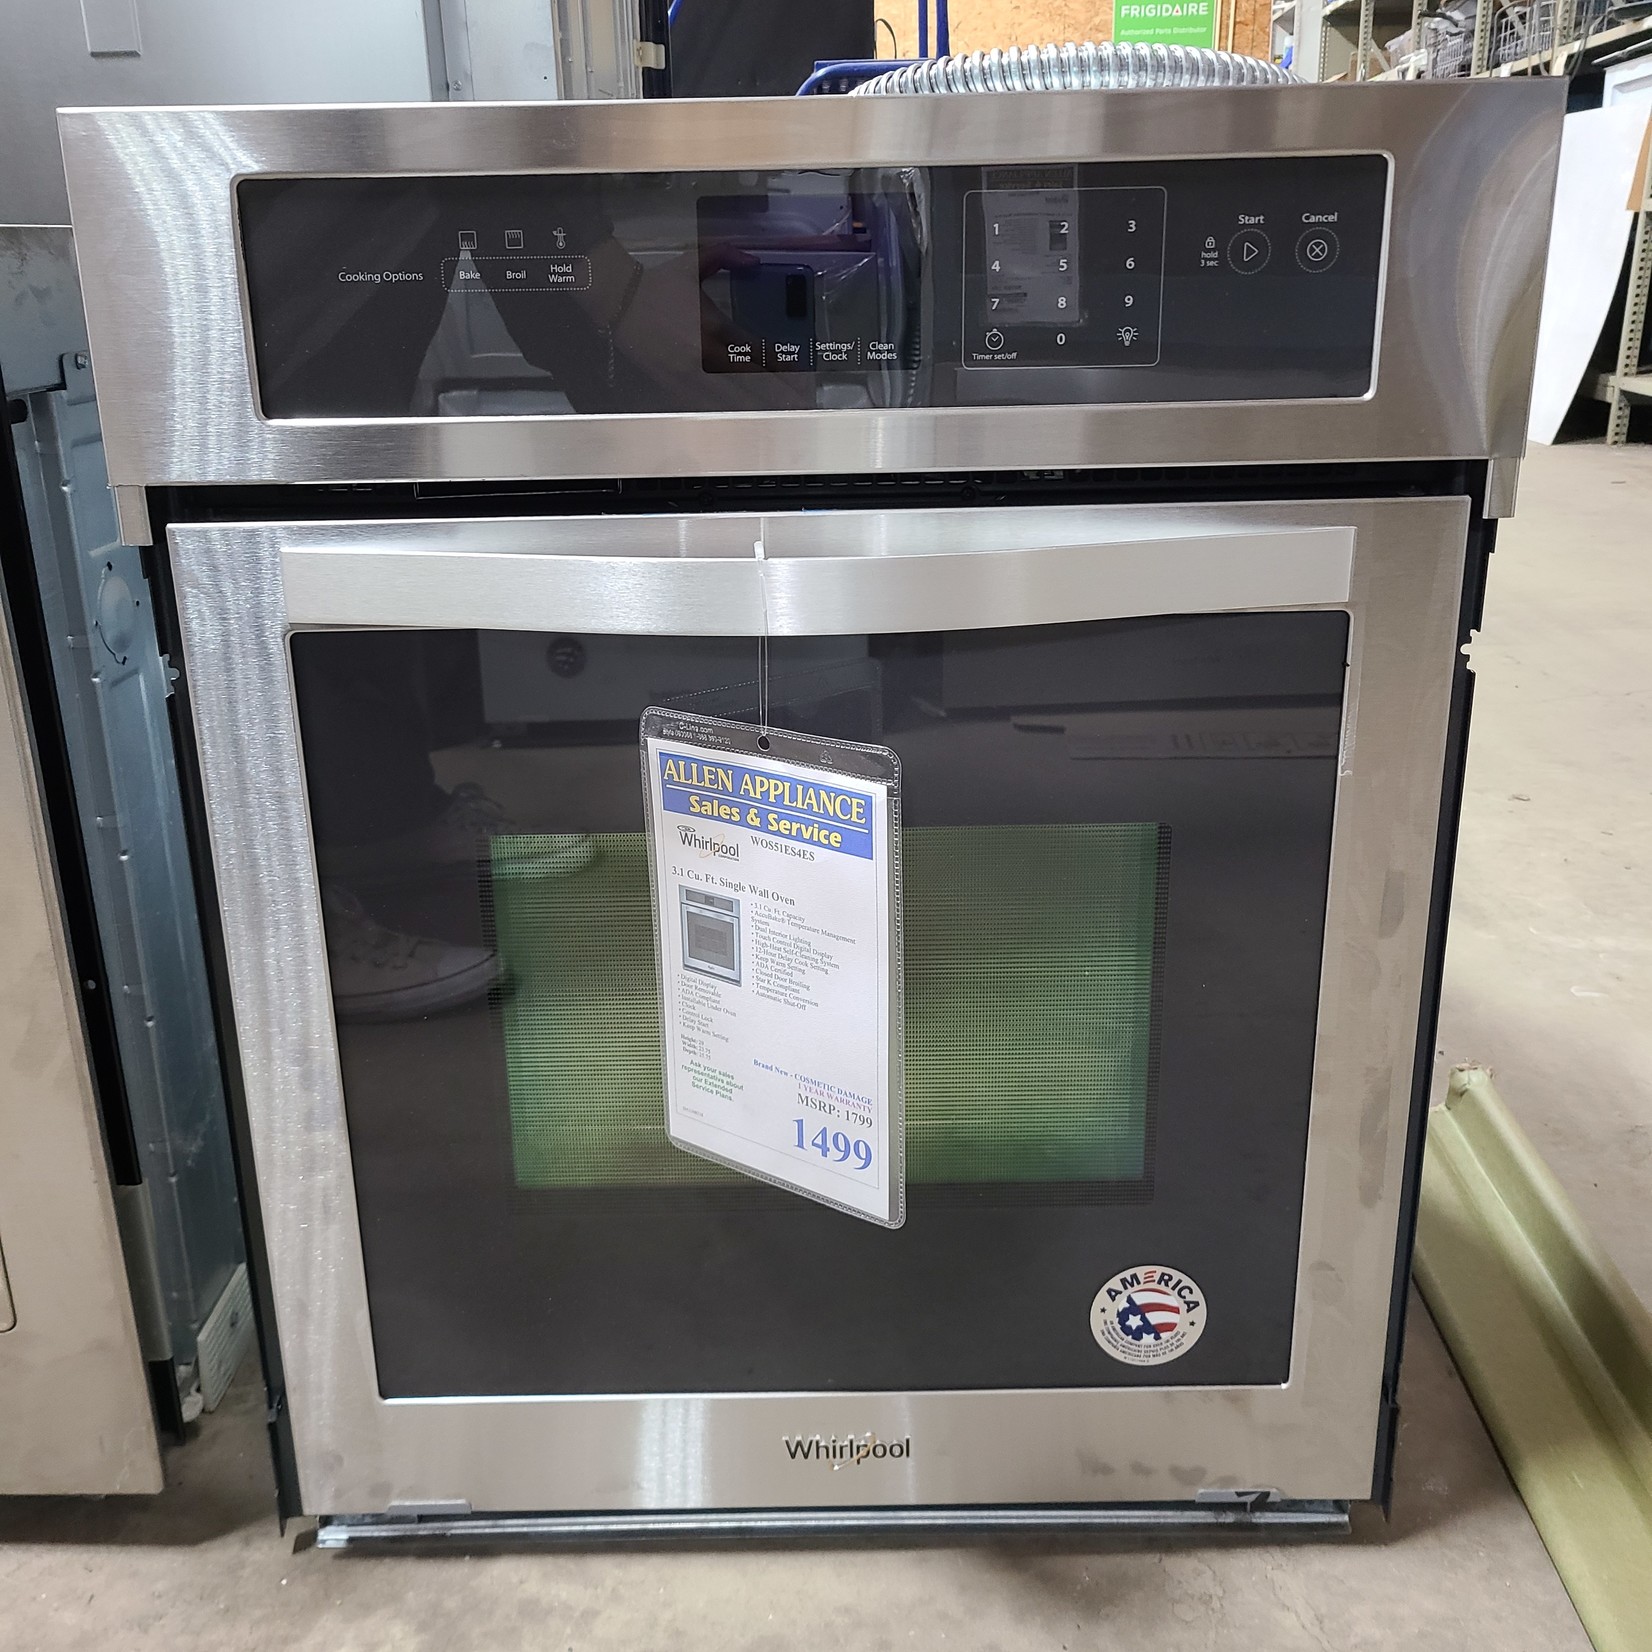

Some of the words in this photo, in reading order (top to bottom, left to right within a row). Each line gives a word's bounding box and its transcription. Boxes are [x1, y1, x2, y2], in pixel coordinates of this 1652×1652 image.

[1121, 3, 1208, 18] FRIGIDAIRE
[1238, 215, 1264, 224] Start
[1302, 212, 1337, 222] Cancel
[993, 224, 999, 235] 1
[1060, 222, 1069, 233] 2
[1128, 220, 1136, 232] 3
[551, 263, 572, 273] Hold
[992, 260, 1000, 272] 4
[1059, 259, 1067, 270] 5
[1126, 258, 1134, 269] 6
[338, 271, 380, 283] Cooking
[383, 270, 423, 282] Options
[459, 270, 481, 280] Bake
[506, 270, 526, 280] Broil
[548, 274, 575, 283] Warm
[991, 299, 999, 310] 7
[1058, 297, 1066, 309] 8
[1125, 295, 1133, 307] 9
[1057, 333, 1065, 345] 0
[728, 344, 751, 353] Cook
[775, 343, 800, 354] Delay
[816, 342, 855, 353] Settings/
[870, 342, 894, 350] Clean
[728, 354, 750, 362] Time
[777, 353, 798, 361] Start
[823, 352, 848, 360] Clock
[867, 351, 897, 360] Modes
[663, 759, 733, 792] ALLEN
[740, 773, 866, 824] APPLIANCE
[690, 795, 740, 821] Sales
[747, 809, 761, 827] &
[768, 814, 842, 847] Service
[679, 831, 739, 857] Whirlpool
[751, 836, 815, 861] WOS51ES4ES
[672, 866, 684, 877] 3.1
[687, 870, 702, 881] Cu.
[706, 874, 717, 885] Ft.
[720, 878, 746, 892] Single
[749, 885, 769, 899] Wall
[772, 891, 795, 906] Oven
[751, 916, 770, 926] System
[782, 911, 805, 923] Capacity
[755, 925, 767, 934] Dual
[769, 928, 788, 938] Interior
[789, 934, 811, 947] Lighting
[787, 919, 820, 934] Temperature
[821, 929, 856, 944] Management
[755, 932, 771, 941] Touch
[772, 937, 792, 948] Control
[793, 943, 811, 954] Digital
[813, 949, 833, 960] Display
[755, 939, 782, 952] High-Heat
[783, 948, 818, 964] Self-Cleaning
[820, 959, 839, 970] System
[756, 947, 776, 958] 12-Hour
[778, 953, 793, 964] Delay
[795, 958, 808, 967] Cook
[810, 963, 829, 975] Setting
[756, 954, 769, 963] Keep
[770, 958, 786, 967] Warm
[787, 963, 805, 975] Setting
[756, 962, 769, 970] ADA
[771, 966, 793, 977] Certified
[681, 974, 697, 984] Digital
[756, 968, 773, 978] Closed
[774, 974, 787, 983] Door
[789, 978, 810, 991] Broiling
[773, 981, 800, 994] Compliant
[756, 983, 787, 998] Temperature
[789, 993, 818, 1007] Conversion
[756, 990, 782, 1003] Automatic
[783, 998, 806, 1011] Shut-Off
[682, 1001, 696, 1010] Clock
[682, 1008, 700, 1018] Control
[701, 1015, 713, 1023] Lock
[683, 1015, 696, 1024] Delay
[690, 1060, 701, 1068] Ask
[703, 1065, 717, 1073] your
[719, 1070, 734, 1080] sales
[682, 1064, 724, 1083] representative
[726, 1081, 744, 1090] about
[754, 1059, 773, 1071] Brand
[775, 1066, 788, 1077] New
[794, 1073, 835, 1093] COSMETIC
[837, 1088, 873, 1106] DAMAGE
[692, 1081, 714, 1094] Service
[716, 1090, 734, 1102] Plans.
[704, 1078, 733, 1094] Extended
[803, 1084, 824, 1098] YEAR
[826, 1093, 873, 1114] WARRANTY
[797, 1093, 840, 1118] MSRP:
[845, 1110, 873, 1128] 1799
[793, 1119, 872, 1170] 1499
[1106, 1270, 1200, 1313] AMERICA
[783, 1434, 911, 1465] Whirlpool
